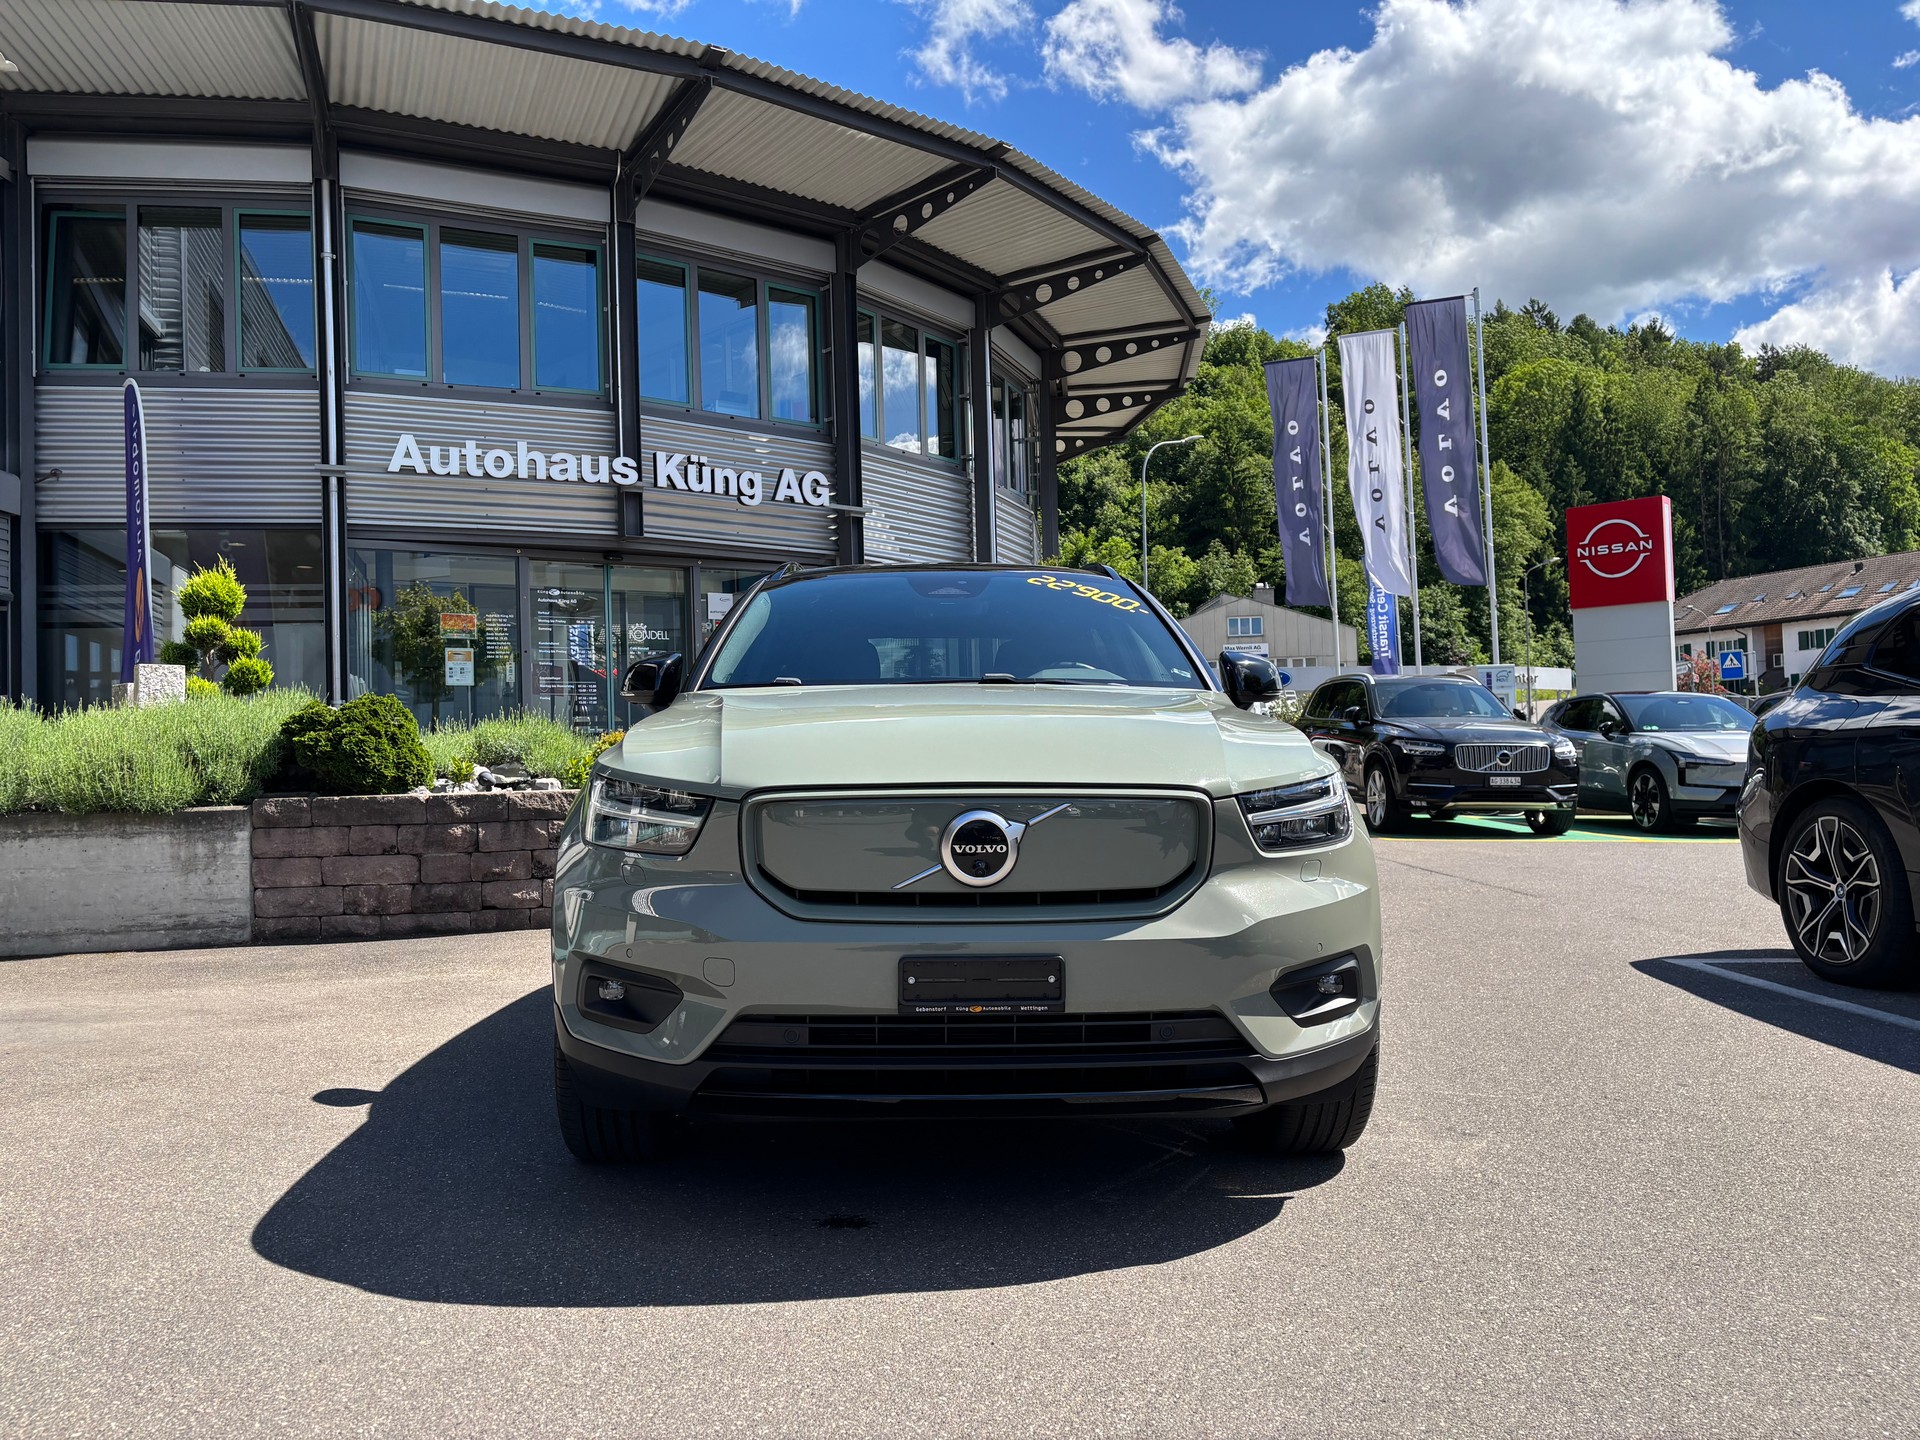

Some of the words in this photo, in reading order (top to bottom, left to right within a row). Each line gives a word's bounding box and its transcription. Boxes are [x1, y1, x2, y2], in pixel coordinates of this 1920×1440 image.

[387, 433, 639, 486] Autohaus
[653, 450, 763, 506] Küng
[773, 467, 830, 507] AG
[1577, 539, 1653, 558] NISSAN
[1515, 672, 1539, 683] nter
[952, 844, 1007, 853] VOLVO
